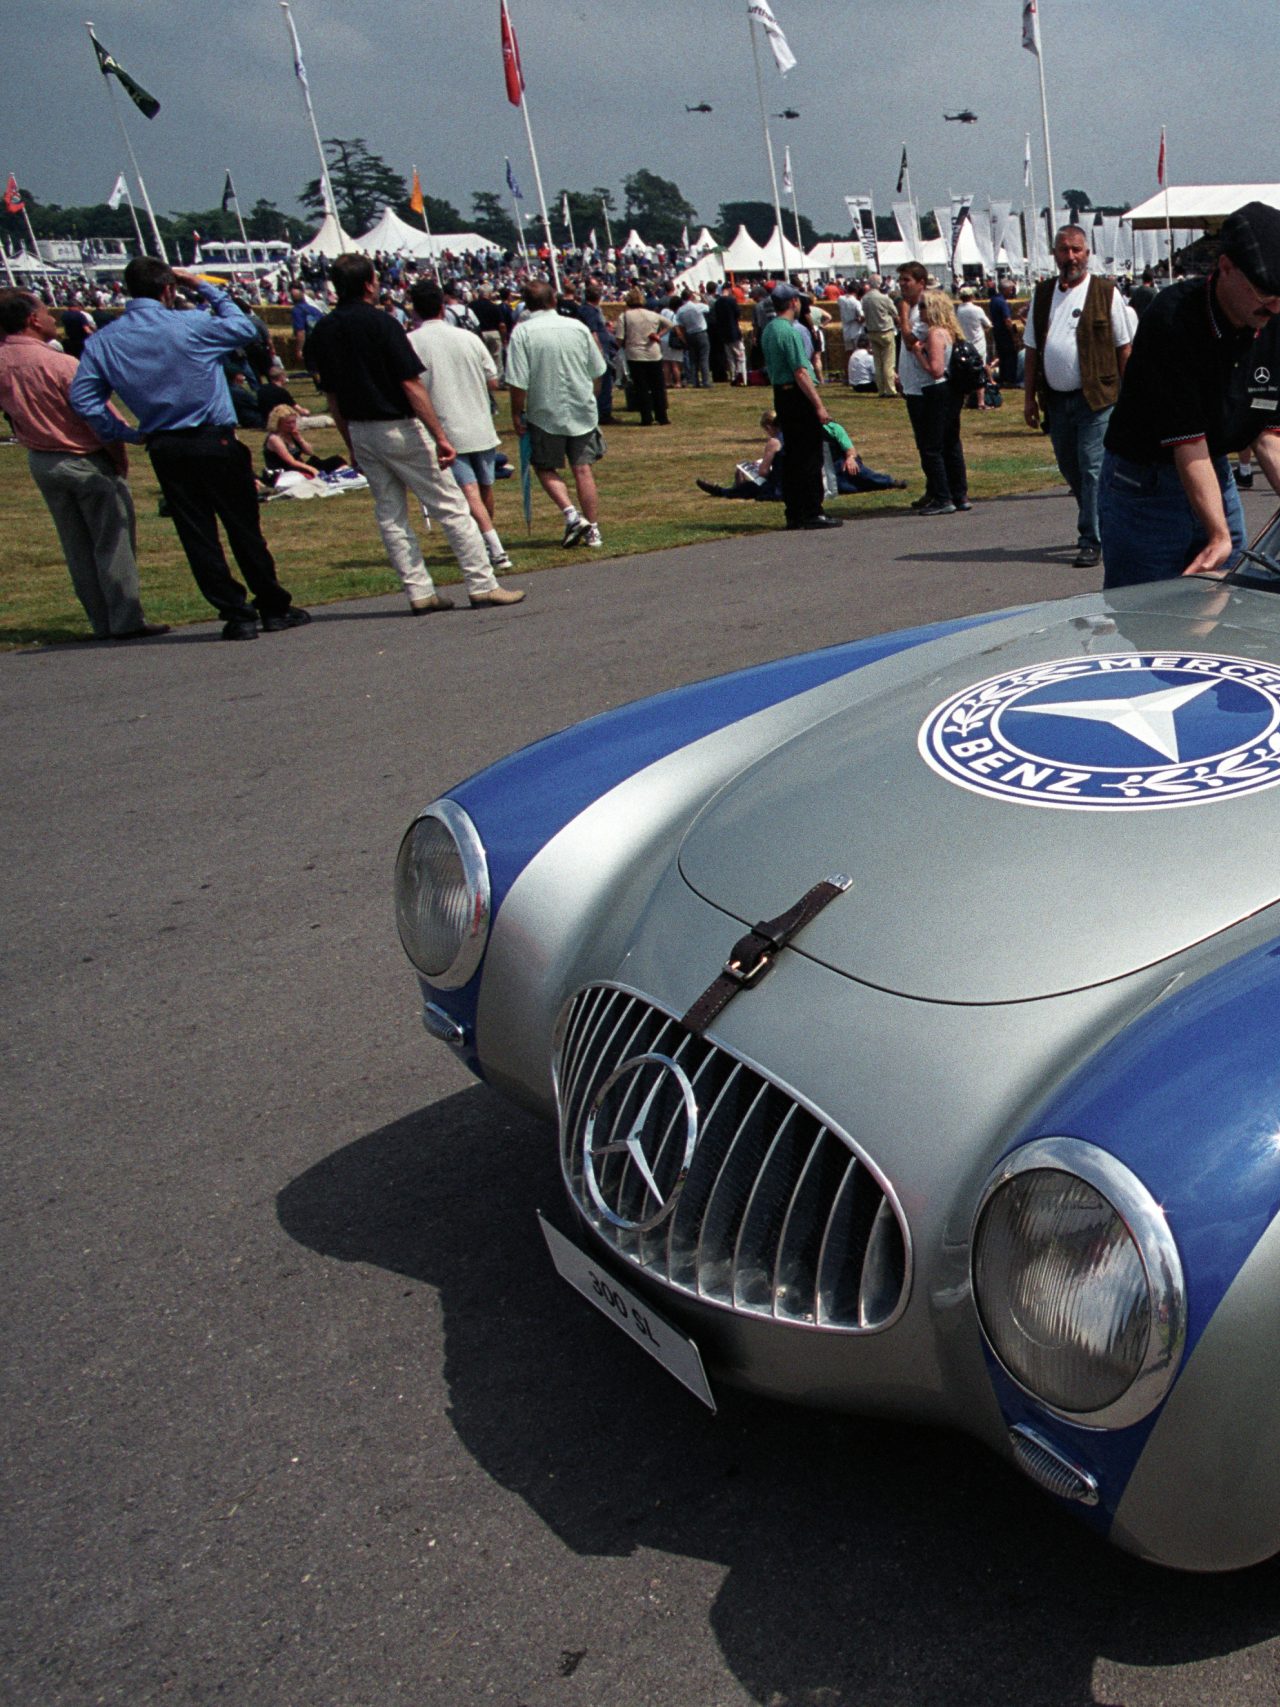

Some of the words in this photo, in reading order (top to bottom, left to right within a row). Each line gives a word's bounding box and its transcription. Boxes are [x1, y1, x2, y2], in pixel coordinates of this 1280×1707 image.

[950, 737, 1092, 794] BENZ
[588, 1270, 628, 1318] 300
[632, 1308, 661, 1347] SL
